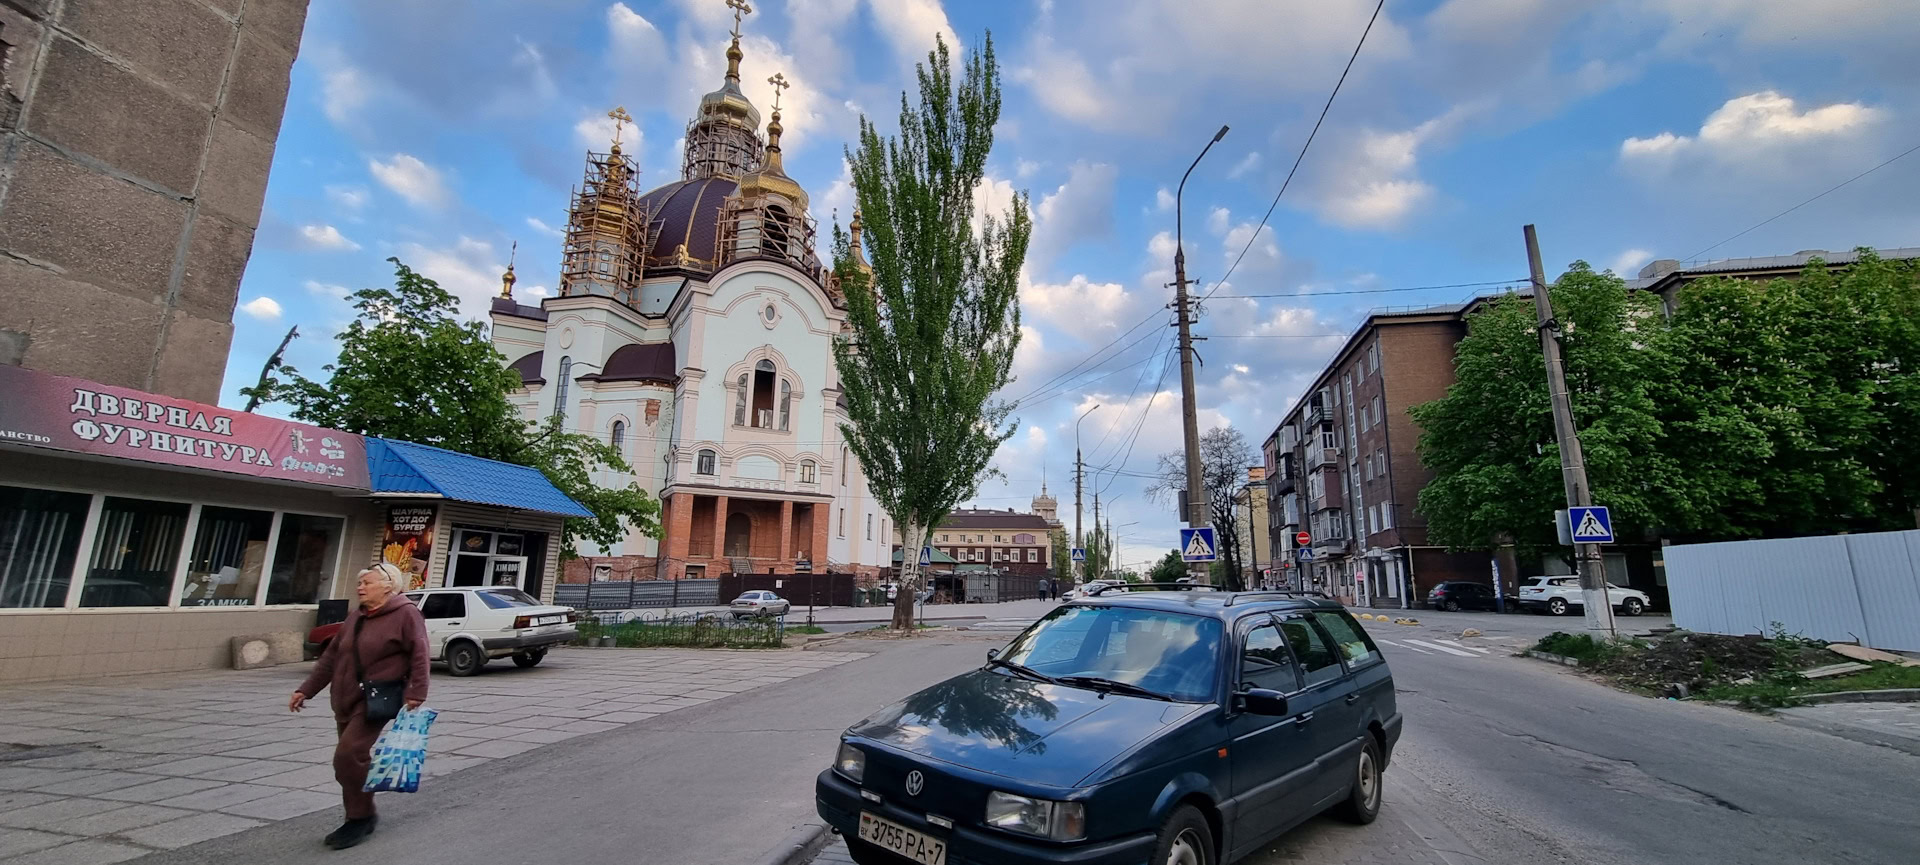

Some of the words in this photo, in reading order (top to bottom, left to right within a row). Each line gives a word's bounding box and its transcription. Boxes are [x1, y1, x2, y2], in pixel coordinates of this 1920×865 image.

[70, 388, 233, 436] ДВЕРНАЯ
[71, 419, 274, 467] ФУРНИТУРА
[391, 508, 432, 516] ШАУРМА
[411, 516, 430, 524] ДОГ
[393, 523, 426, 531] БУРГЕР
[860, 827, 869, 836] BY
[871, 820, 904, 850] 3755
[905, 832, 943, 865] PA-7
